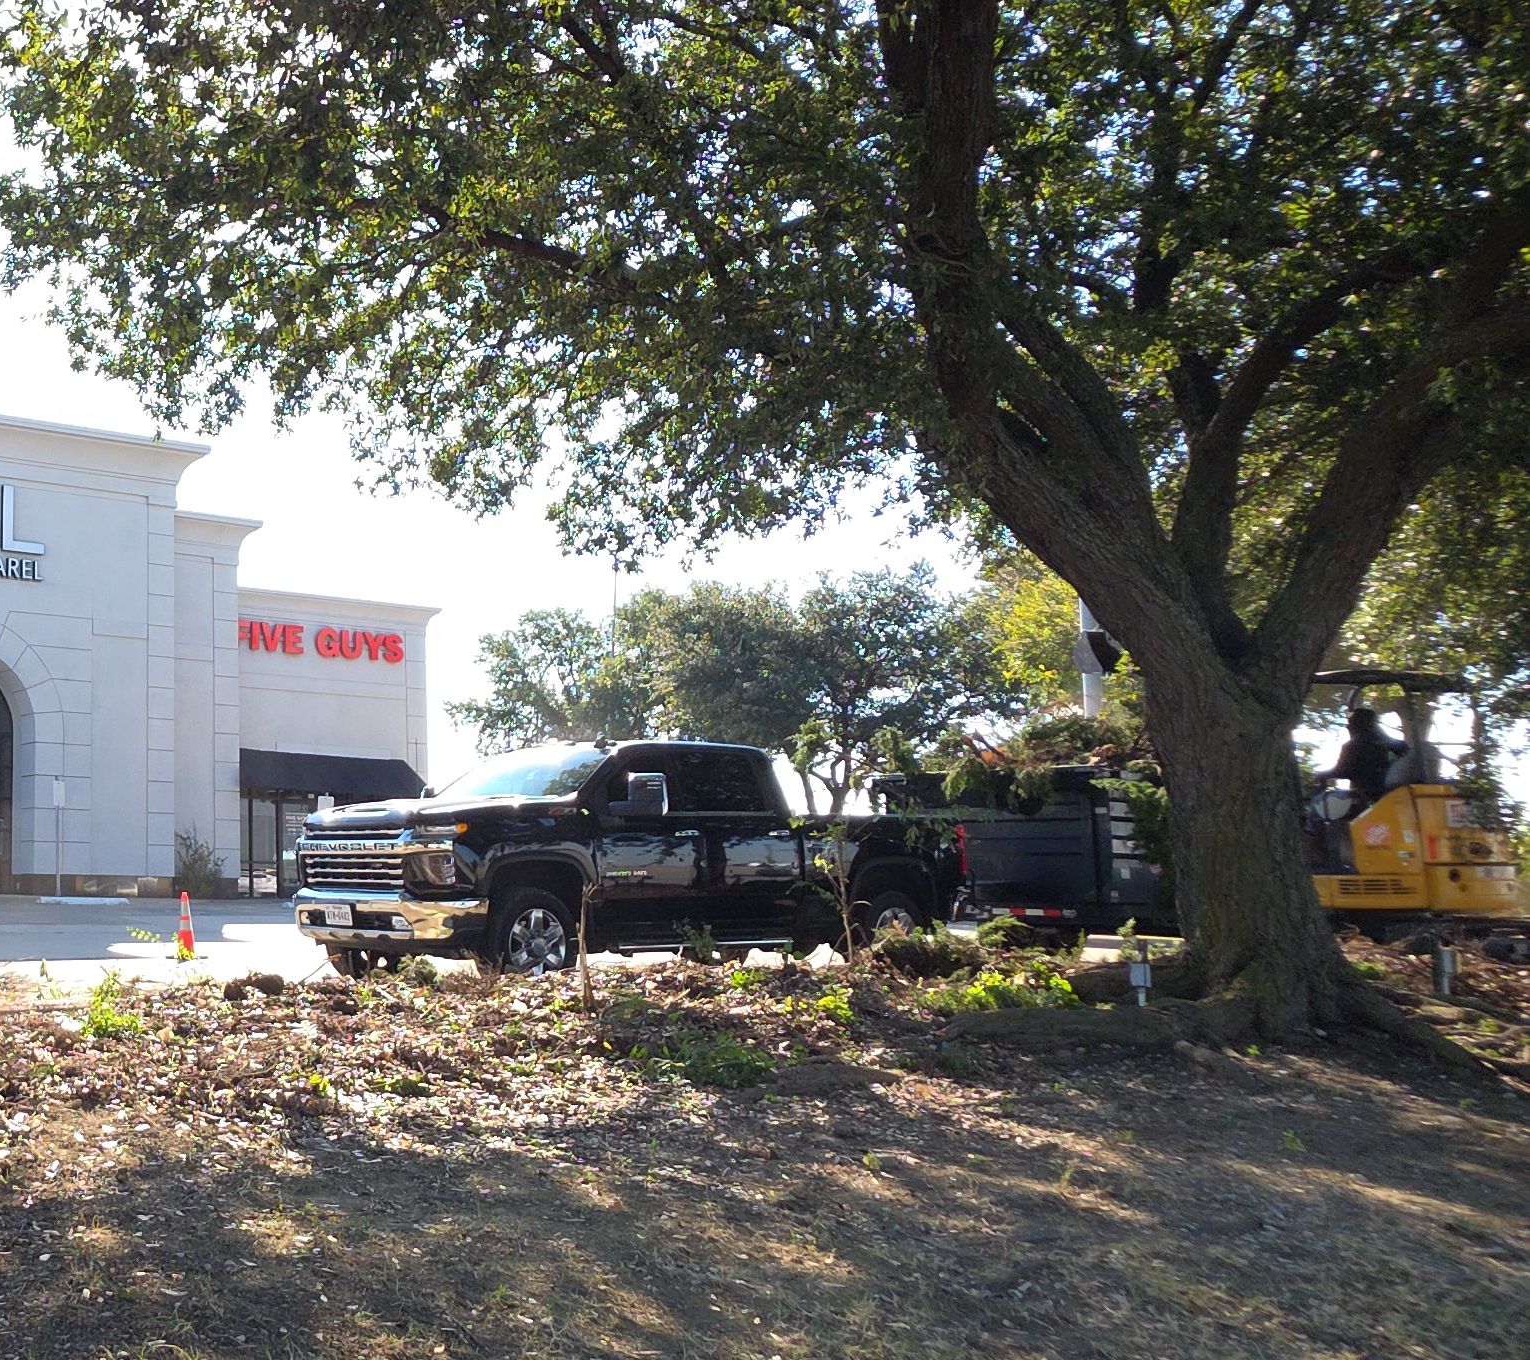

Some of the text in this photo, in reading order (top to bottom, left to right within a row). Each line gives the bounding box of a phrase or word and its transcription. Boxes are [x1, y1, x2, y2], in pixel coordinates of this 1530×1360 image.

[238, 619, 405, 664] FIVE GUYS
[300, 842, 399, 851] CHEVROLET
